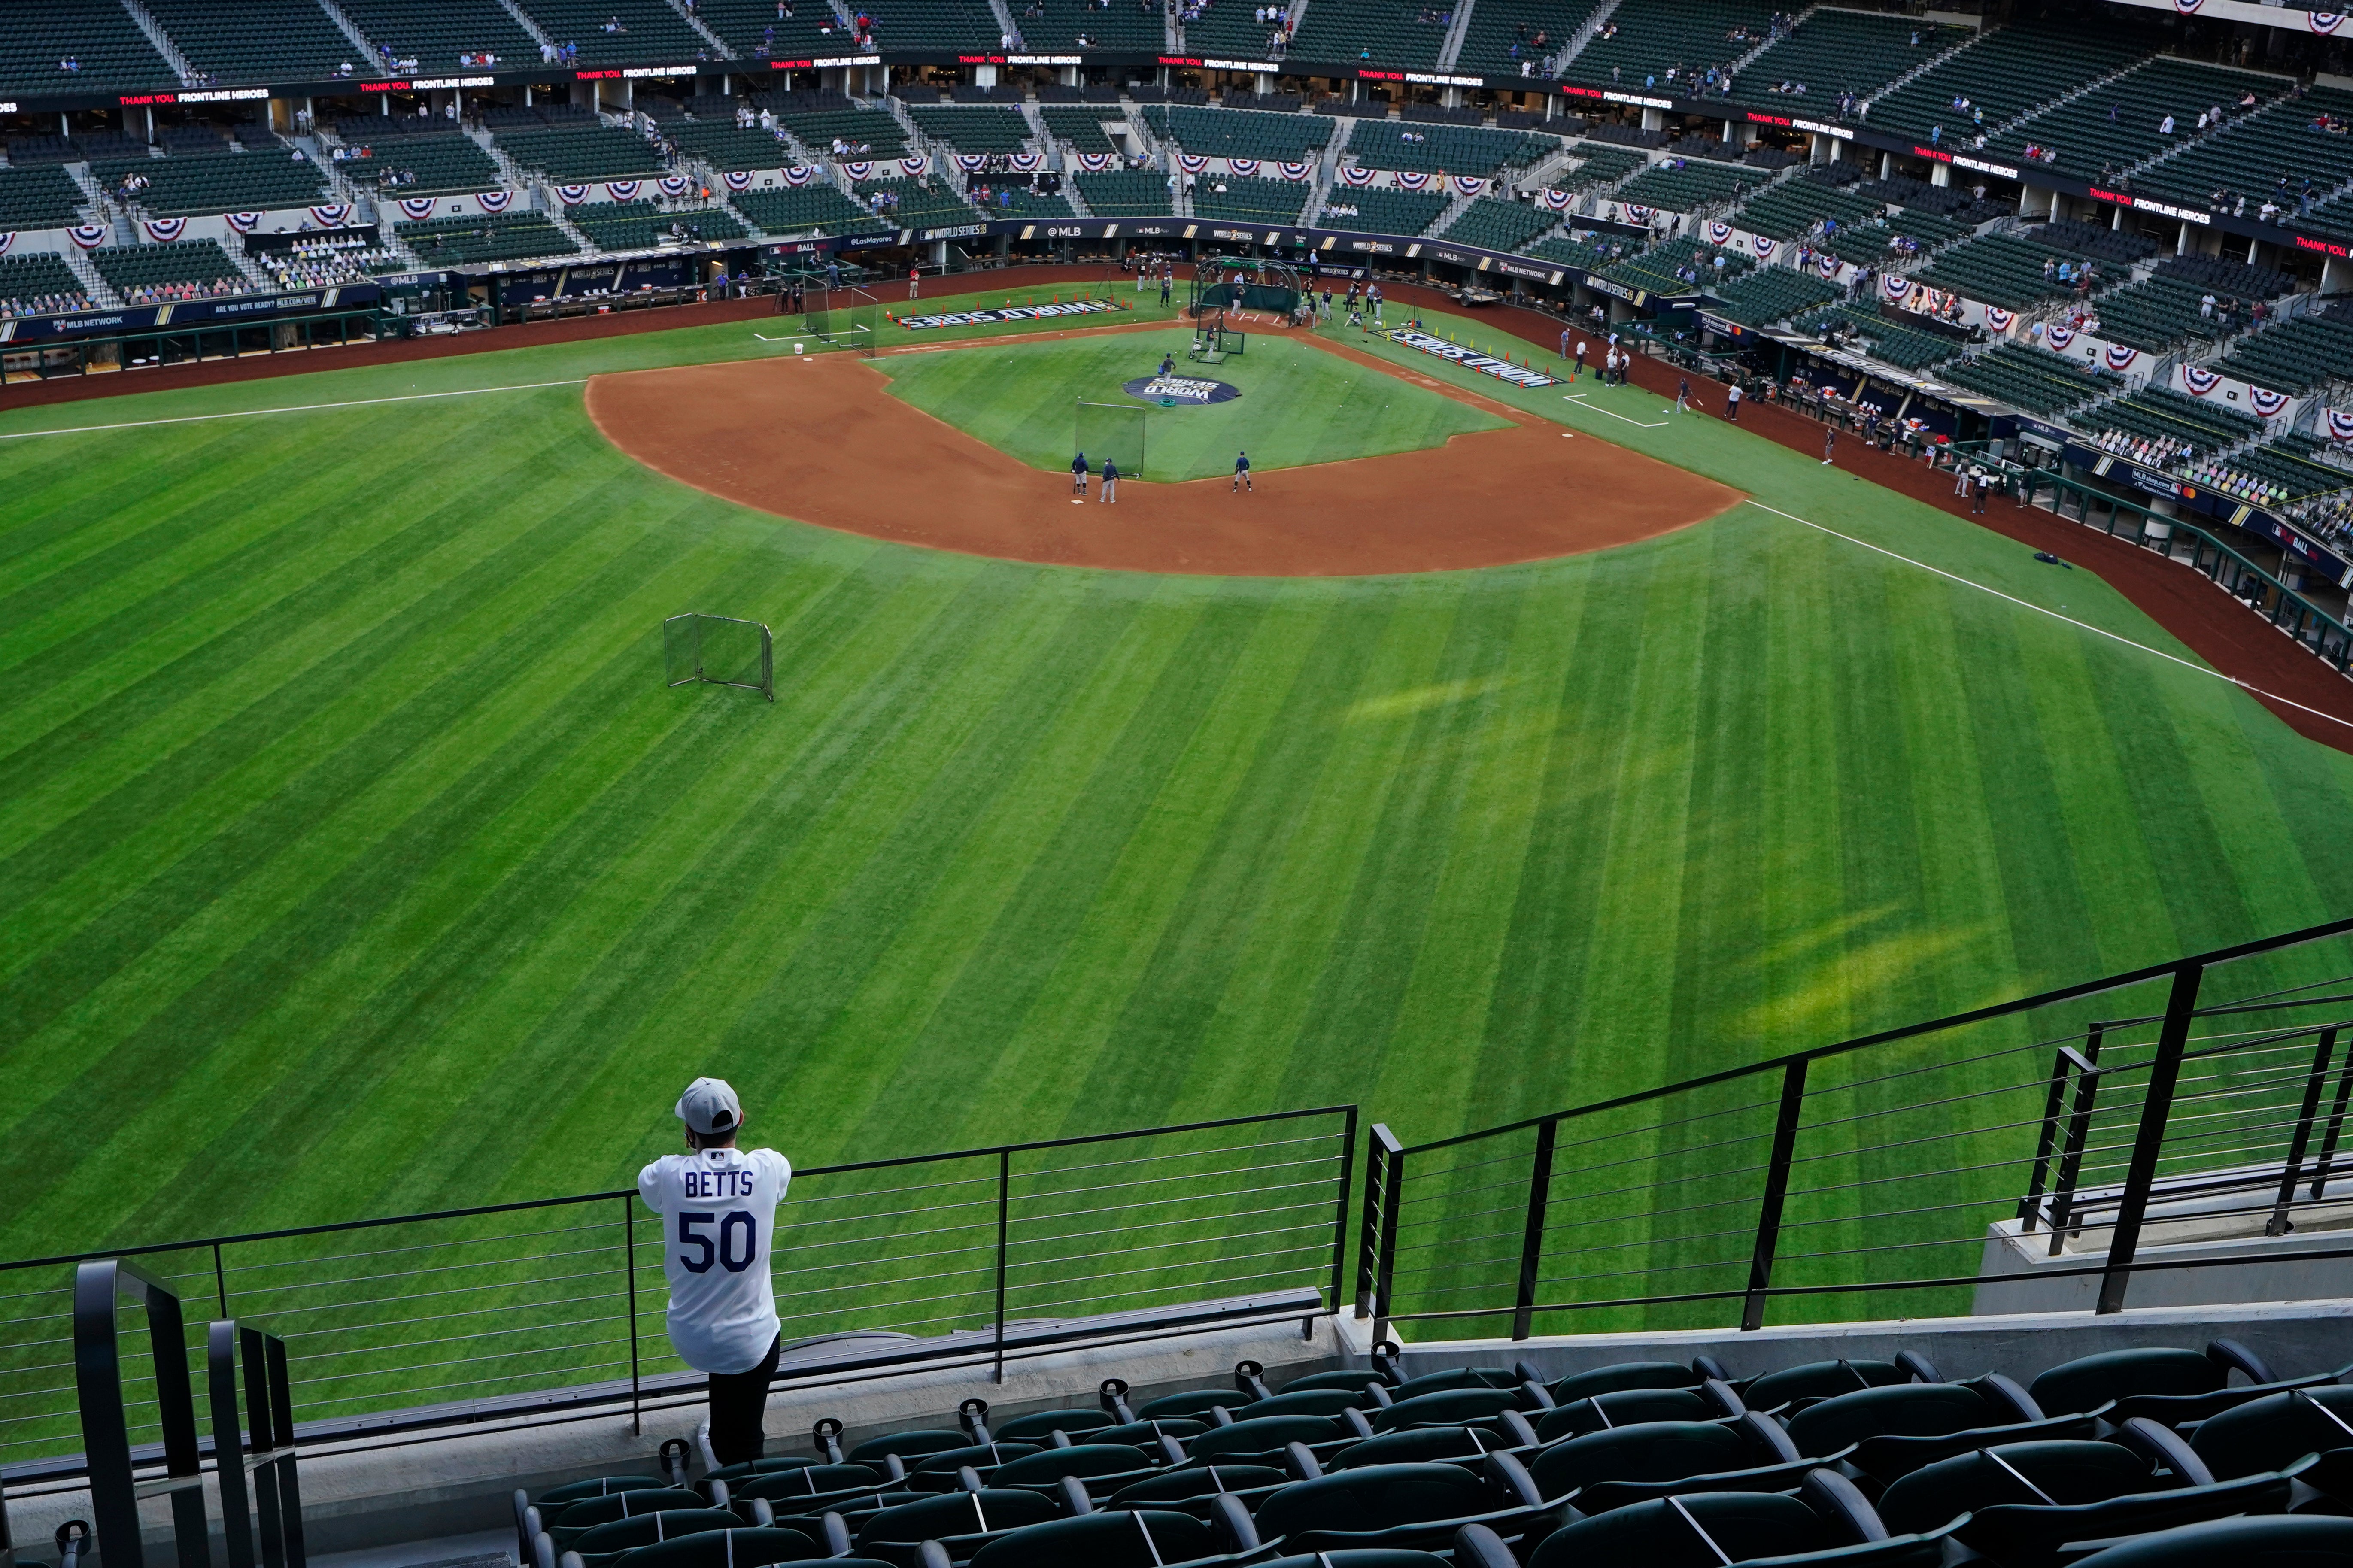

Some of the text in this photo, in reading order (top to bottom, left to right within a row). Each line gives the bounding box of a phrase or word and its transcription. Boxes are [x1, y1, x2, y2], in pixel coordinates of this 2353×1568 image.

[813, 58, 852, 67] FRONTLINE
[852, 56, 880, 65] HEROES
[1007, 56, 1050, 64] FRONTLINE
[1051, 55, 1082, 64] HEROES
[1204, 59, 1247, 69] FRONTLINE
[1247, 62, 1279, 72] HEROES
[576, 66, 697, 80] THANK YOU. FRONTLINE HEROES
[1358, 70, 1483, 86] THANK YOU. FRONTLINE HEROES
[360, 77, 494, 91] THANK YOU. FRONTLINE HEROES
[119, 89, 269, 105] THANK YOU. FRONTLINE HEROES
[1562, 86, 1673, 109] THANK YOU. FRONTLINE HEROES
[1747, 112, 1854, 140] THANK YOU. FRONTLINE HEROES
[1914, 146, 2018, 179] THANK YOU. FRONTLINE HEROES
[2089, 188, 2211, 225] THANK YOU. FRONTLINE HEROES
[935, 227, 958, 239] WORLD
[958, 224, 980, 237] SERIES
[1214, 230, 1231, 238] WORLD
[1236, 232, 1253, 240] SERIES
[797, 243, 816, 252] BALL
[851, 236, 893, 246] @LasMayores
[1353, 242, 1370, 250] WORLD
[1376, 244, 1393, 252] SERIES
[2296, 237, 2326, 252] THANK
[2327, 244, 2347, 257] YOU.
[1444, 252, 1457, 261] MLB
[571, 269, 591, 279] WORLD
[596, 267, 615, 276] SERIES
[1507, 265, 1545, 279] MLB NETWORK
[390, 275, 419, 285] @MLB
[1594, 277, 1612, 292] WORLD
[1611, 284, 1628, 299] SERIES
[216, 295, 317, 313] ARE YOU VOTE READY? MLB.COM/VOTE
[998, 303, 1100, 319] WORLD
[67, 316, 123, 329] MLB NETWORK
[901, 312, 997, 328] SERIES
[1391, 333, 1479, 358] SERIES
[1463, 357, 1556, 386] WORLD
[1153, 378, 1220, 388] SERIES
[1144, 385, 1209, 399] WORLD
[2038, 424, 2049, 433] MLB
[2292, 537, 2308, 555] BALL
[685, 1171, 753, 1198] BETTS
[679, 1211, 756, 1273] 50
